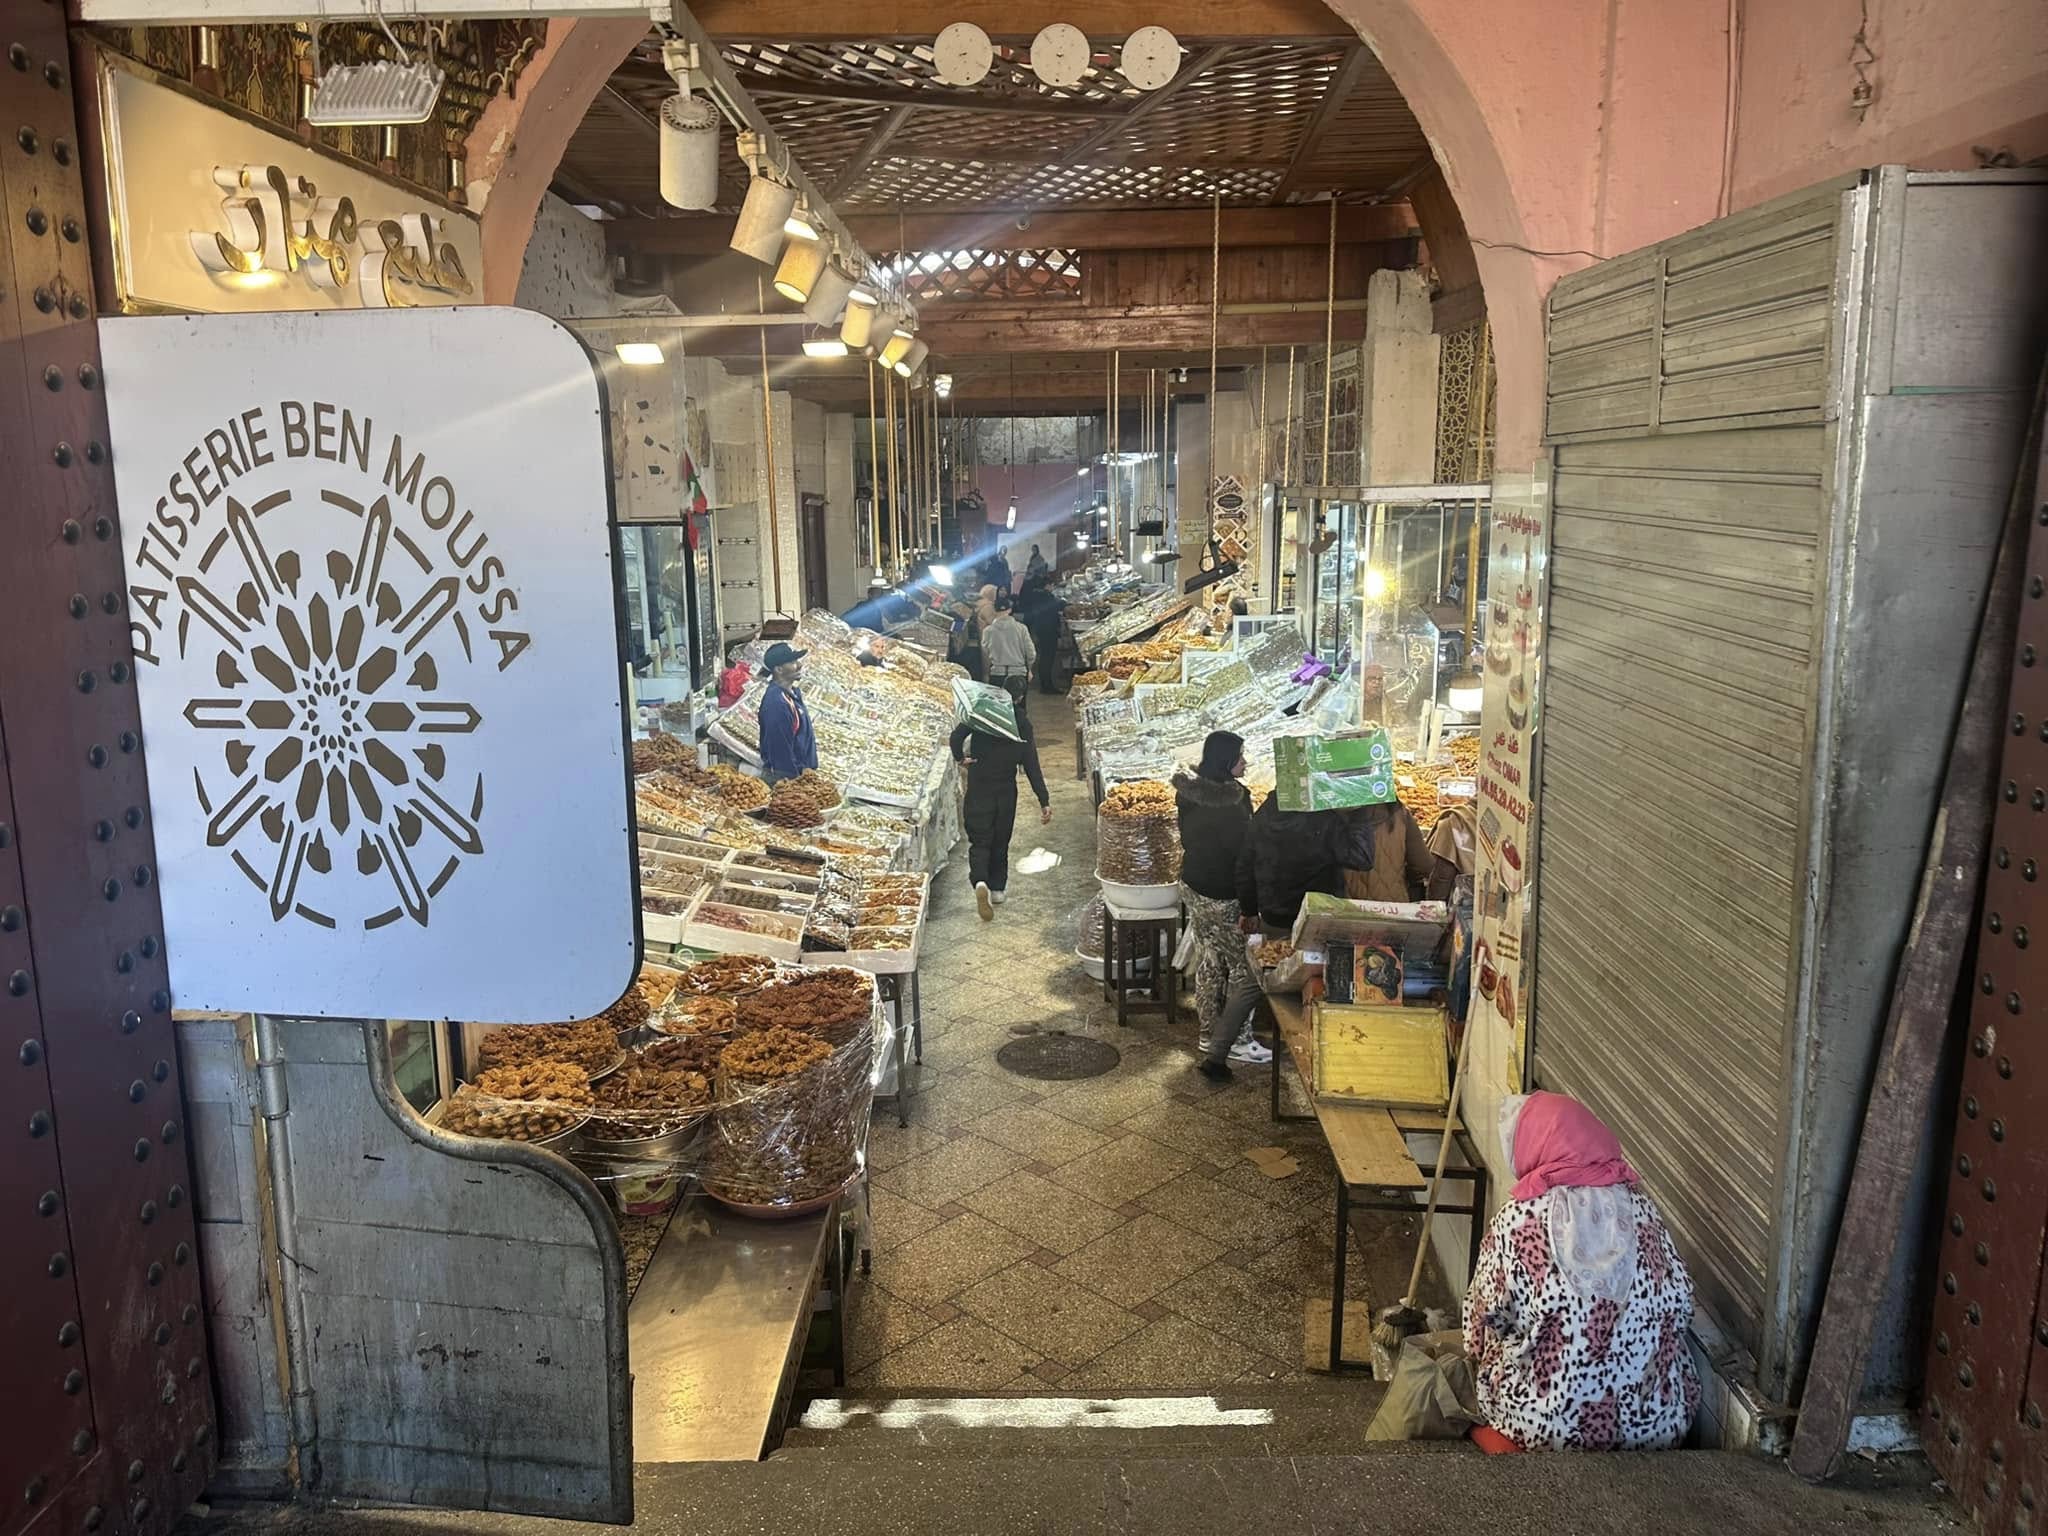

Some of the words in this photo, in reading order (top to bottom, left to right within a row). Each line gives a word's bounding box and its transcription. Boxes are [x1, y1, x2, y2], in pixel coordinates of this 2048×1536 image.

[192, 164, 358, 290] ممتاز
[129, 406, 275, 666] PATISSERIE
[280, 400, 373, 474] BEN
[382, 433, 532, 673] MOUSSA
